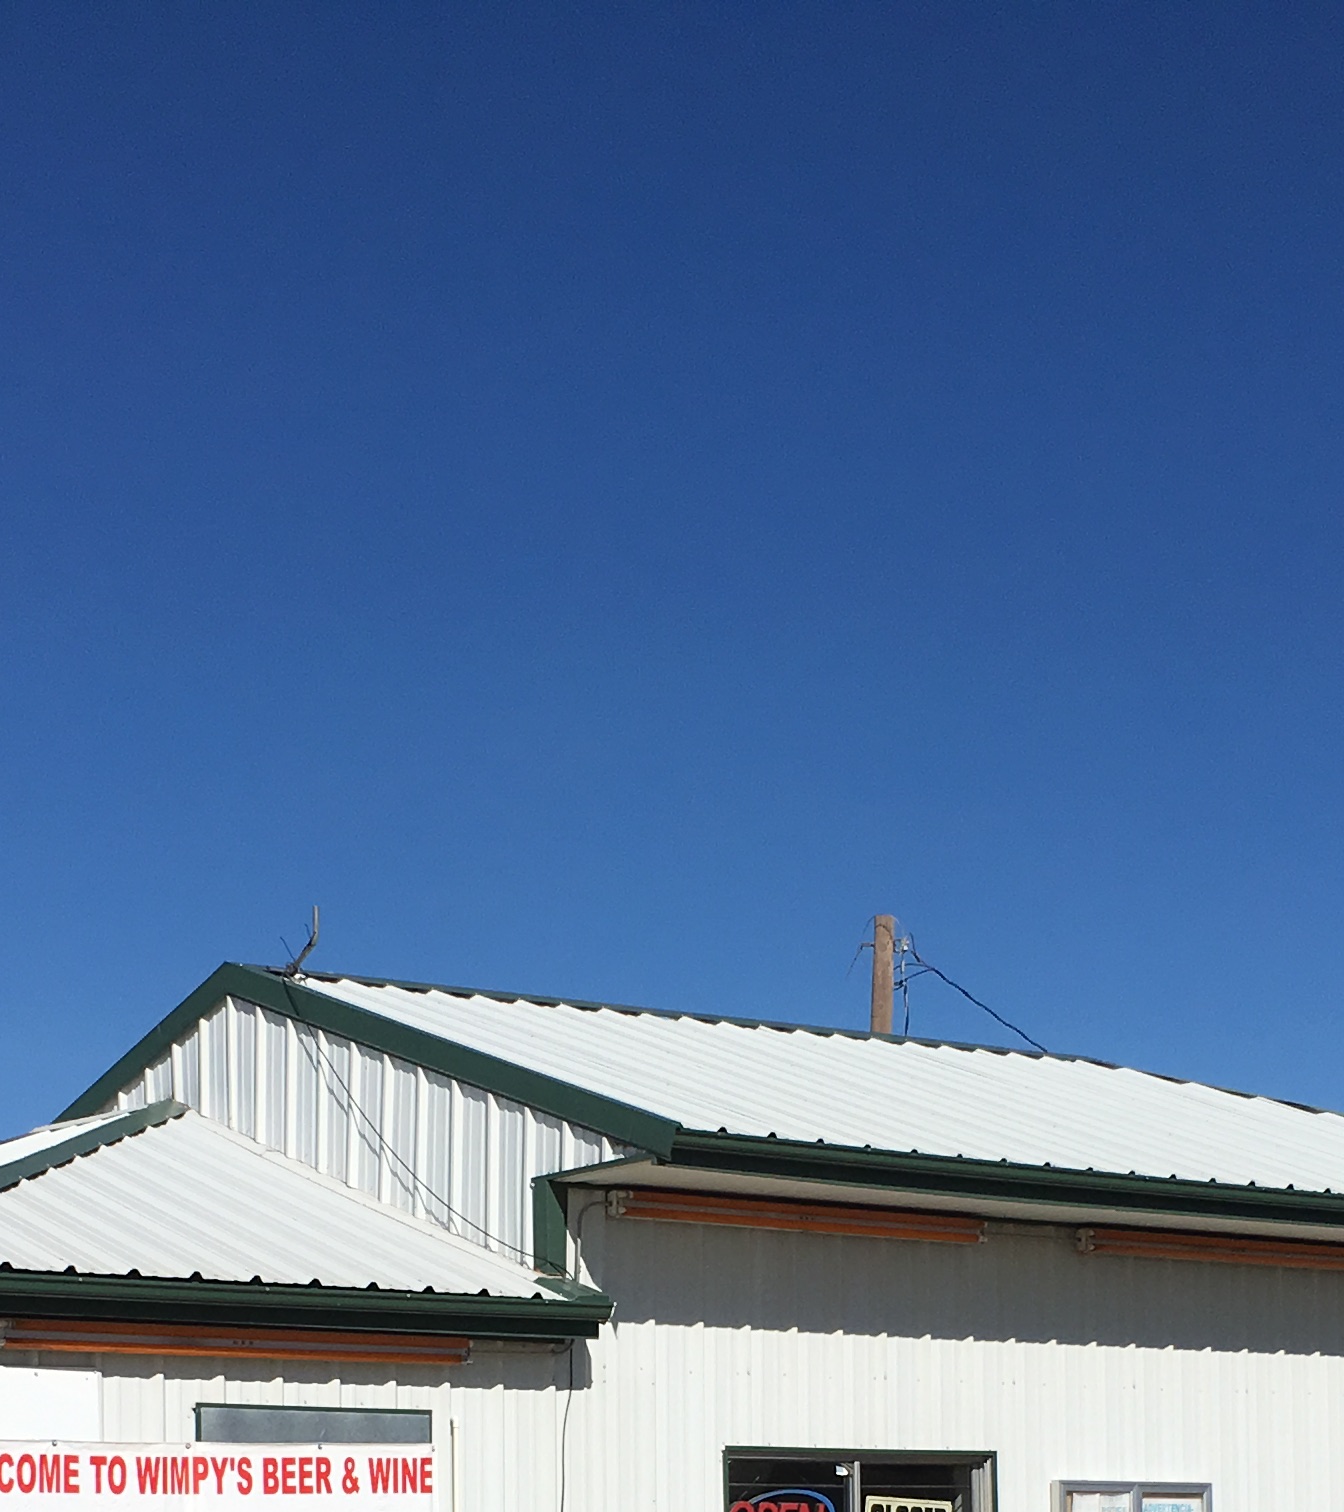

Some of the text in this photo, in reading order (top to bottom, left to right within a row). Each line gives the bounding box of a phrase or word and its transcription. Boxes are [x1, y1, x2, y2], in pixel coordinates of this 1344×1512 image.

[89, 1455, 128, 1494] TO
[136, 1456, 254, 1496] WIMPY'S
[262, 1456, 333, 1495] BEER
[341, 1456, 361, 1495] &
[367, 1457, 433, 1494] WINE
